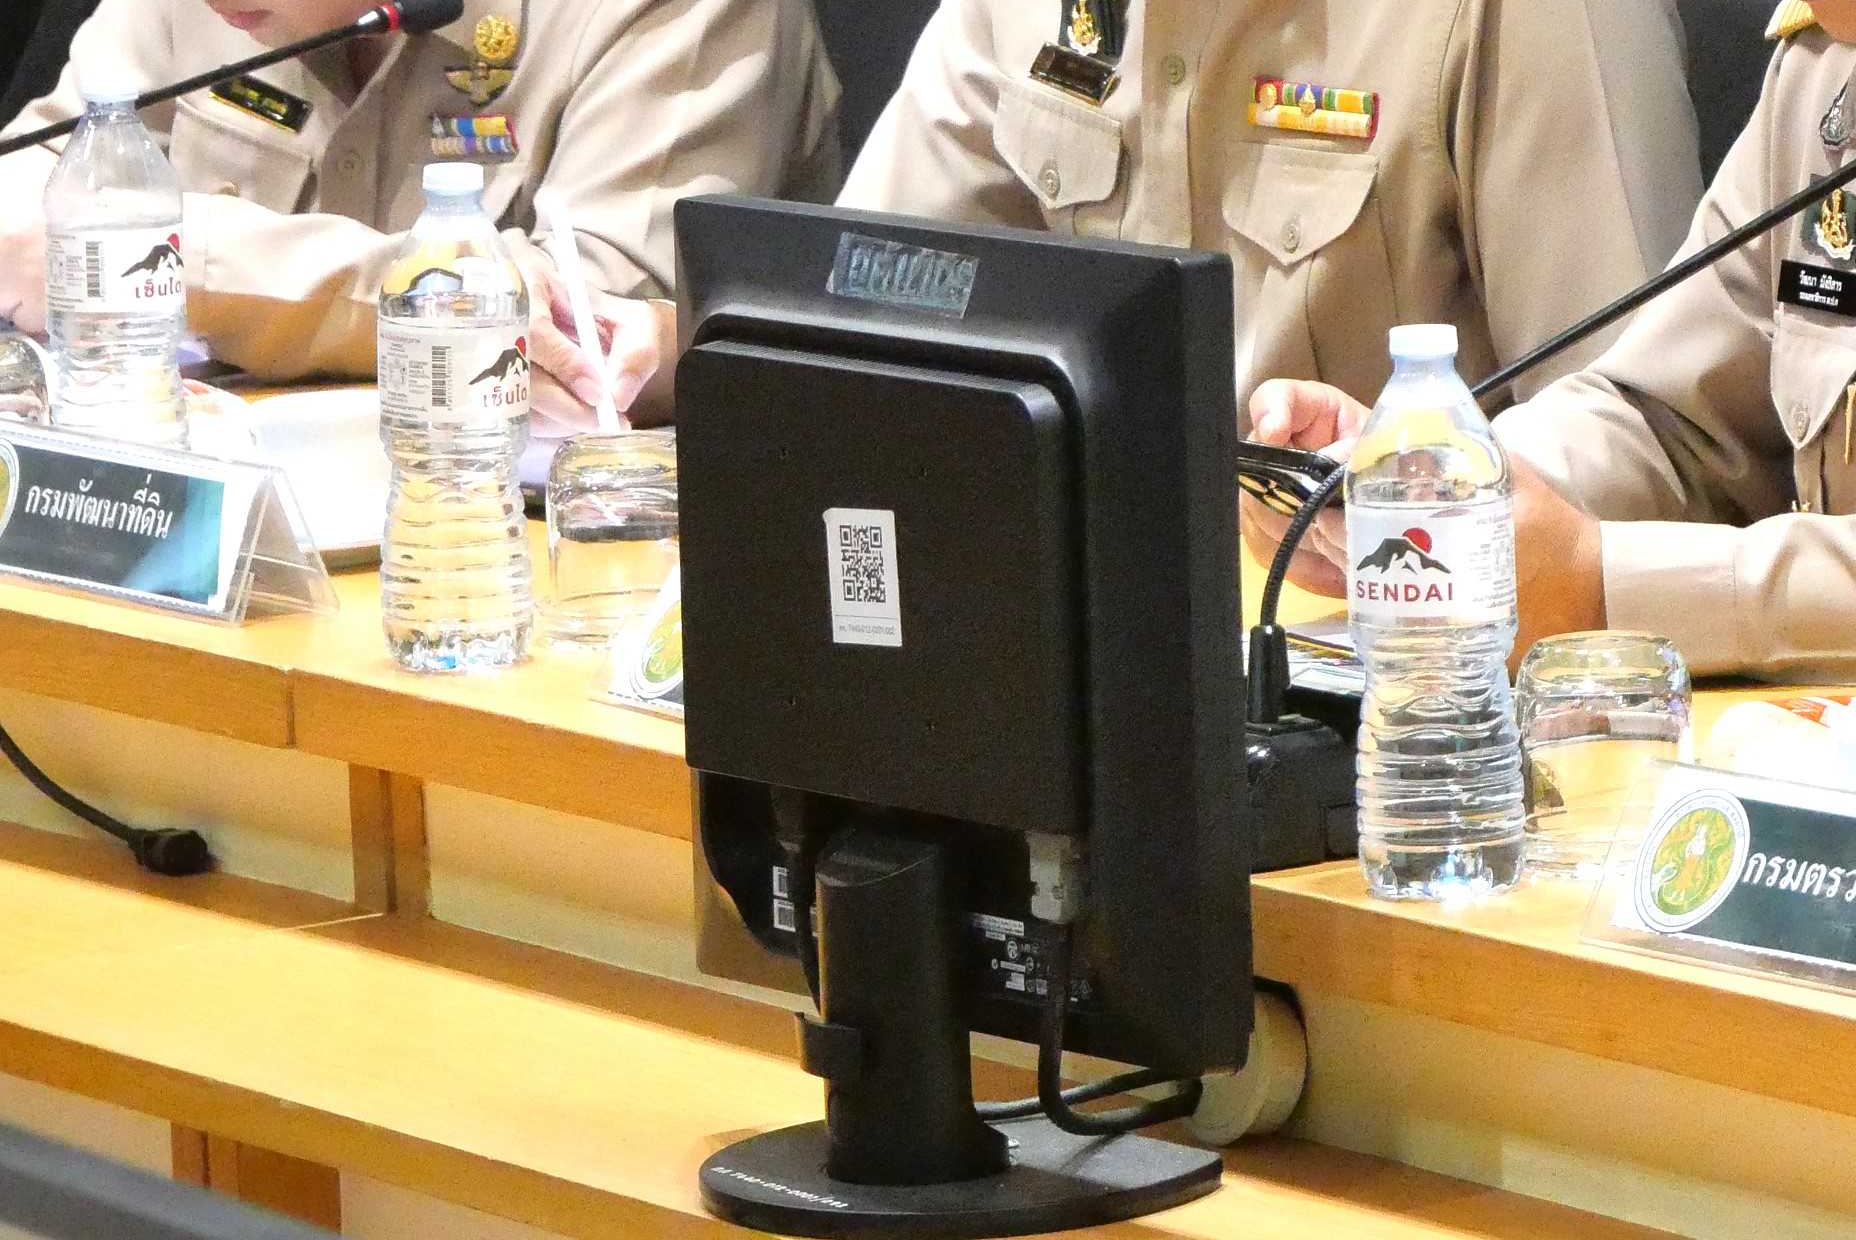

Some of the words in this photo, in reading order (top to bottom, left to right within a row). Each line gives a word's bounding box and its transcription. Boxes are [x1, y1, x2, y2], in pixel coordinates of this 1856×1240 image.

[25, 474, 174, 539] กรมพัฒนาที่ดิน
[1356, 579, 1454, 602] SENDAI
